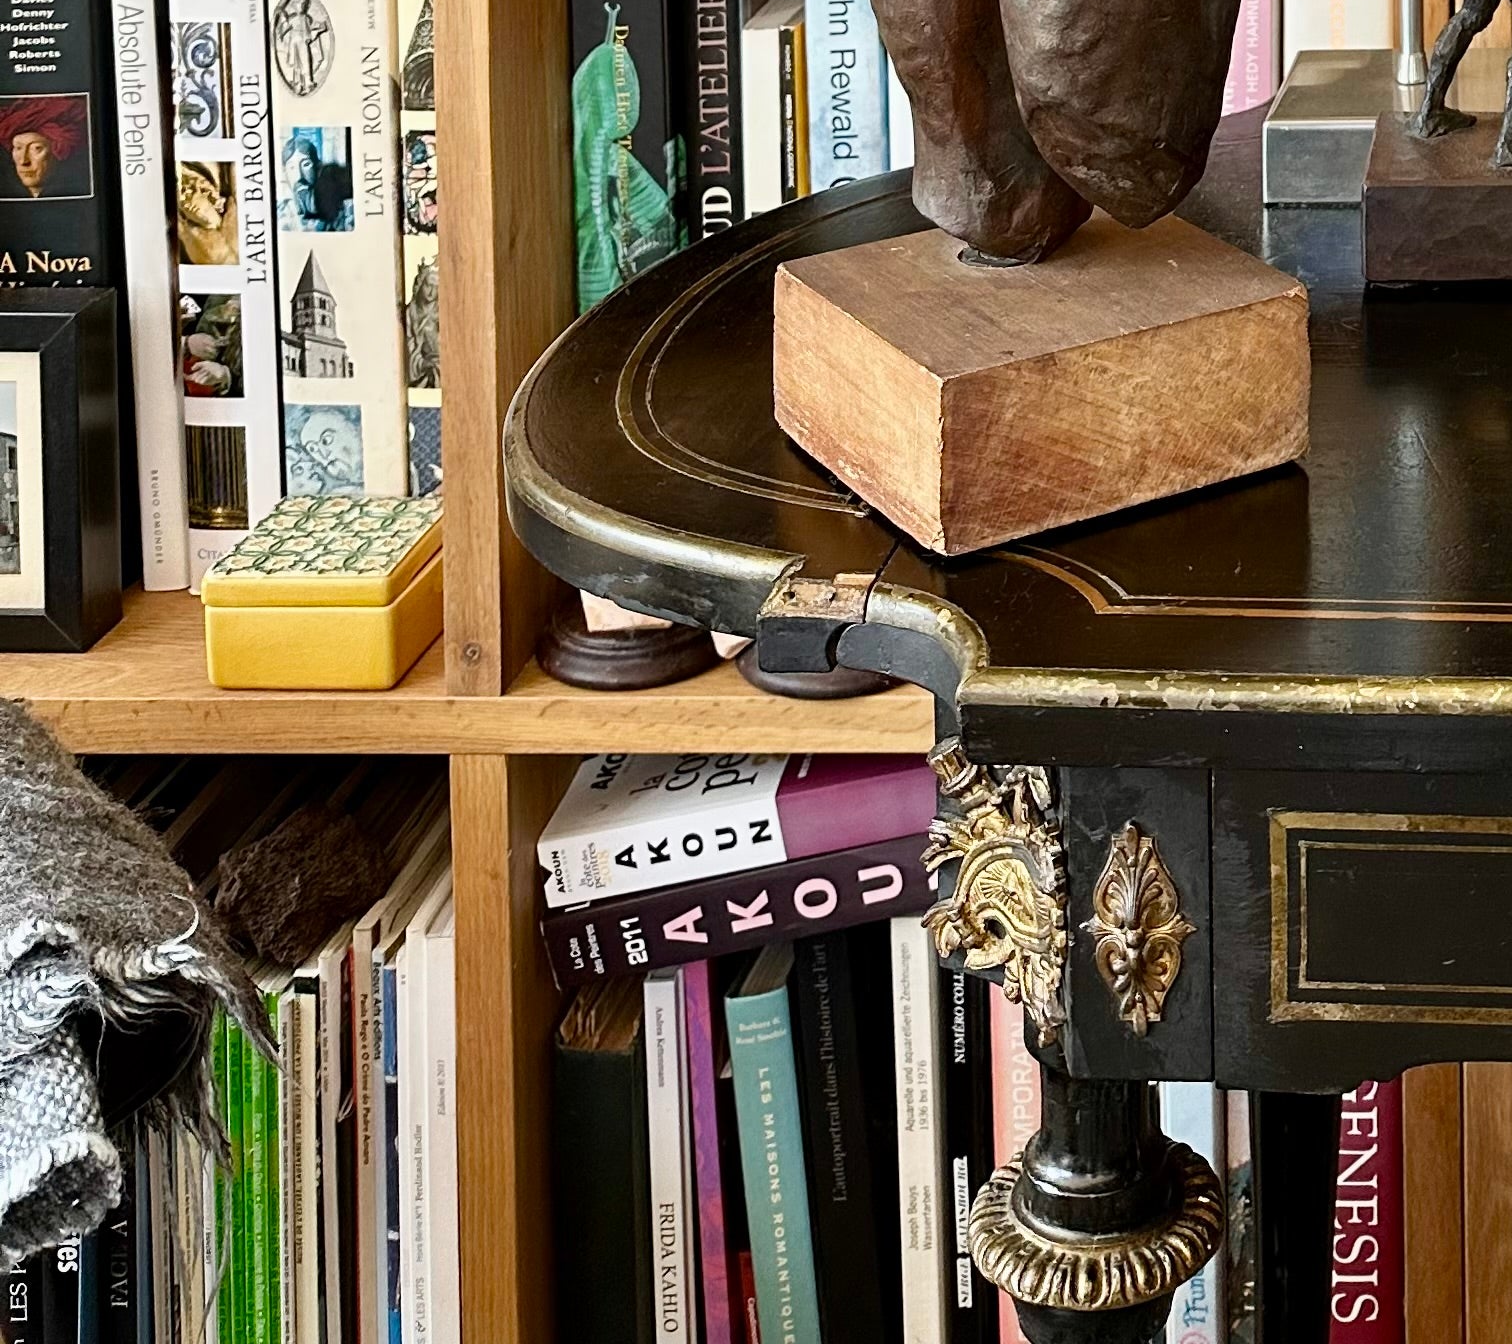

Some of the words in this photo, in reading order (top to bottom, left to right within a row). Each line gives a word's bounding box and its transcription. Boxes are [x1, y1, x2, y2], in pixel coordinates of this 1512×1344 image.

[0, 21, 70, 33] Hofrichter
[11, 8, 55, 20] Denny
[11, 34, 57, 48] Jacobs
[8, 48, 62, 61] Roberts
[13, 62, 58, 74] Simon
[116, 1, 147, 107] Absolute
[359, 45, 383, 144] ROMAN
[829, 48, 860, 162] Rewald
[122, 112, 152, 178] Penis
[239, 72, 268, 212] BAROQUE
[360, 153, 384, 219] L'ART
[0, 253, 18, 274] A
[26, 249, 93, 274] Nova
[245, 214, 268, 285] L'ART
[550, 848, 567, 894] AKOUN
[618, 914, 650, 968] 2011
[757, 1066, 774, 1105] LES
[759, 1112, 784, 1205] MAISONS
[659, 1202, 678, 1261] FRIDA
[906, 1221, 920, 1252] Joseph
[920, 1184, 933, 1253] Wasserfarben
[9, 1280, 29, 1324] LES
[661, 1263, 681, 1335] KAHLO
